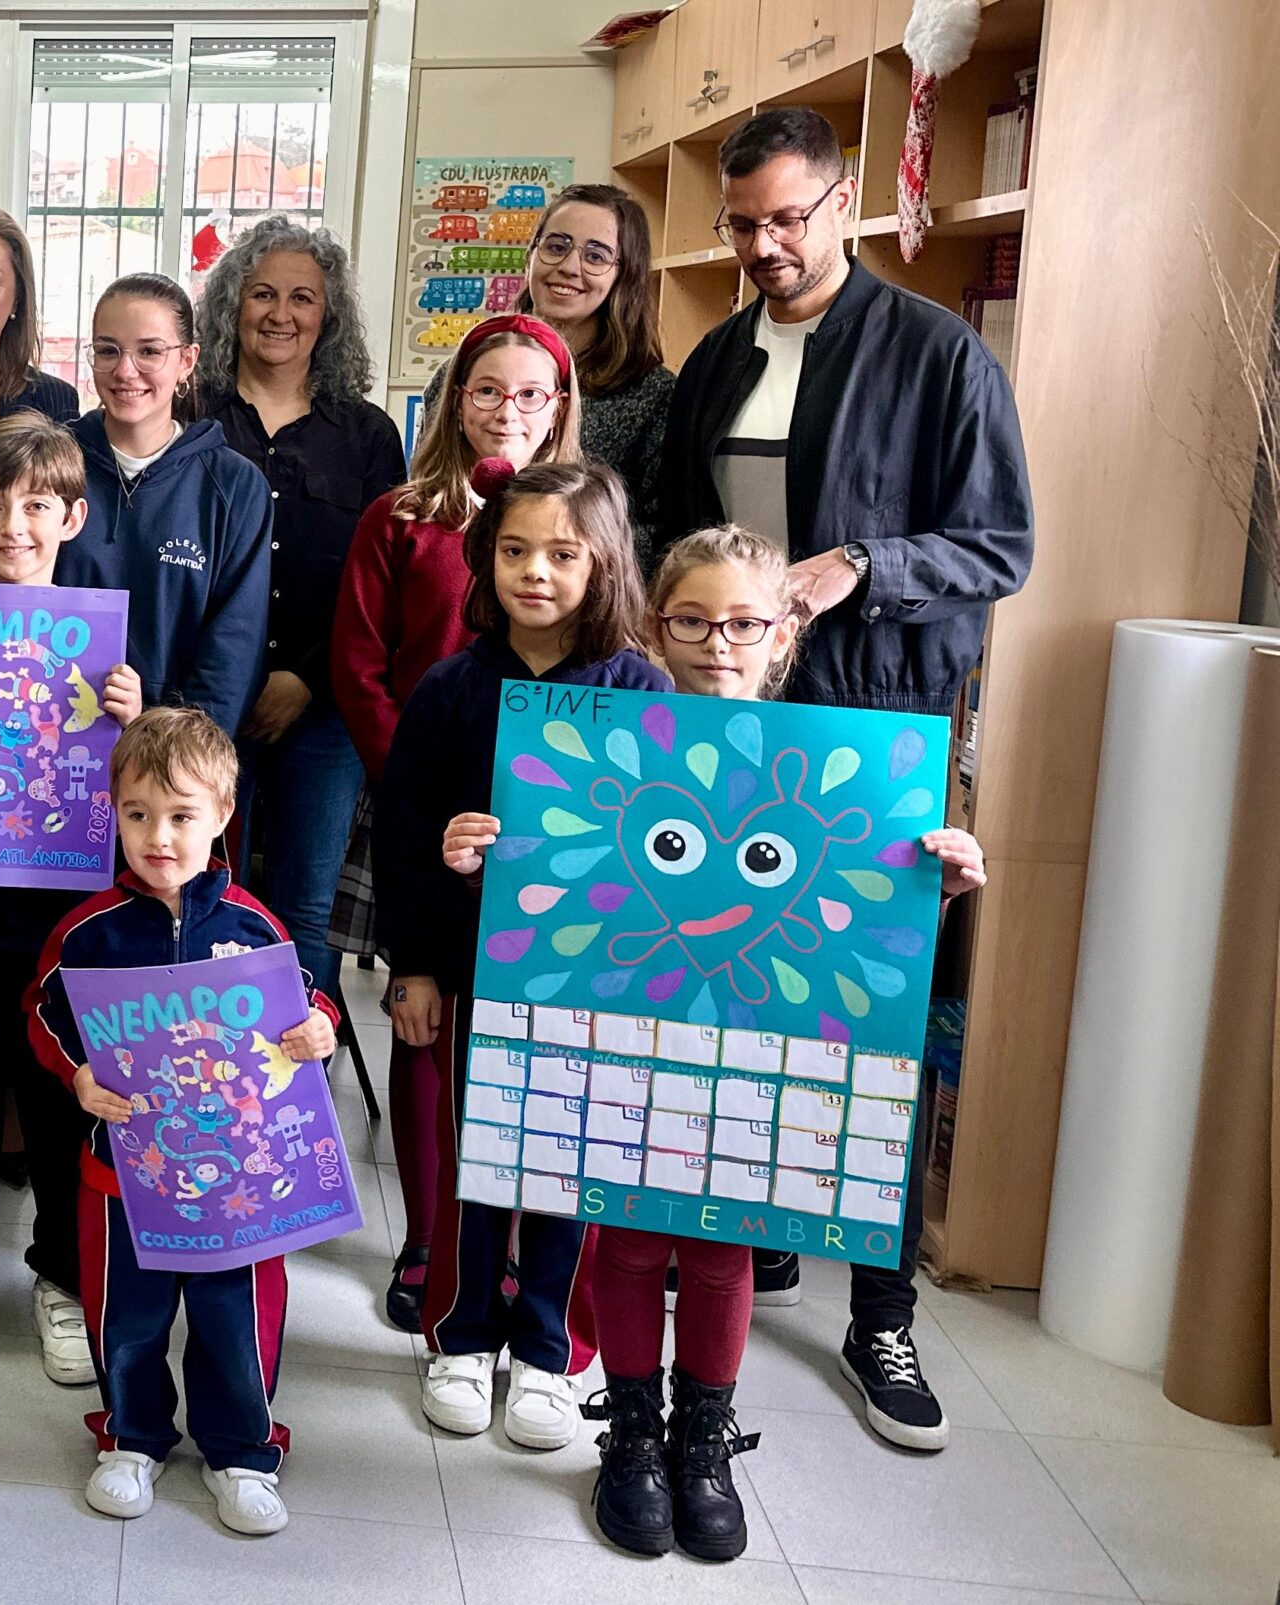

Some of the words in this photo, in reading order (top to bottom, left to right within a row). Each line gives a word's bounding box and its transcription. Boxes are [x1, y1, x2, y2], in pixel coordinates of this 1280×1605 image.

[440, 166, 466, 182] CDU
[472, 164, 550, 182] ILUSTRADA
[158, 538, 206, 564] COLEXIO
[160, 554, 204, 572] ATLÁNTIDA
[87, 790, 112, 844] 2025
[81, 984, 264, 1052] AVEMPO
[516, 1004, 523, 1014] 1
[576, 1012, 587, 1021] 2
[642, 1020, 648, 1028] 3
[704, 1029, 714, 1039] 4
[766, 1035, 774, 1045] 5
[832, 1045, 842, 1054] 6
[513, 1053, 522, 1064] 8
[574, 1060, 581, 1070] 9
[634, 1069, 648, 1080] 10
[697, 1078, 710, 1088] 11
[762, 1086, 776, 1096] 12
[828, 1096, 842, 1106] 13
[895, 1104, 910, 1115] 14
[534, 1046, 582, 1060] MARTES
[594, 1053, 655, 1069] MÉRCORES
[666, 1063, 704, 1077] XOVES
[783, 1078, 830, 1092] SÁBADO
[852, 1044, 911, 1060] DOMINGO
[506, 1090, 521, 1100] 15
[568, 1099, 581, 1110] 16
[692, 1117, 707, 1128] 18
[754, 1122, 770, 1133] 19
[820, 1134, 837, 1144] 20
[888, 1143, 906, 1154] 21
[313, 1137, 344, 1191] 2025
[498, 1169, 515, 1178] 29
[564, 1180, 578, 1190] 30
[501, 1128, 519, 1140] 22
[560, 1138, 578, 1149] 23
[627, 1149, 642, 1158] 24
[688, 1156, 705, 1168] 25
[753, 1166, 770, 1176] 26
[882, 1187, 900, 1199] 28
[138, 1230, 224, 1250] COLEXIO
[232, 1200, 344, 1246] ATLÁNTIDA
[584, 1187, 894, 1255] SETEMBRO
